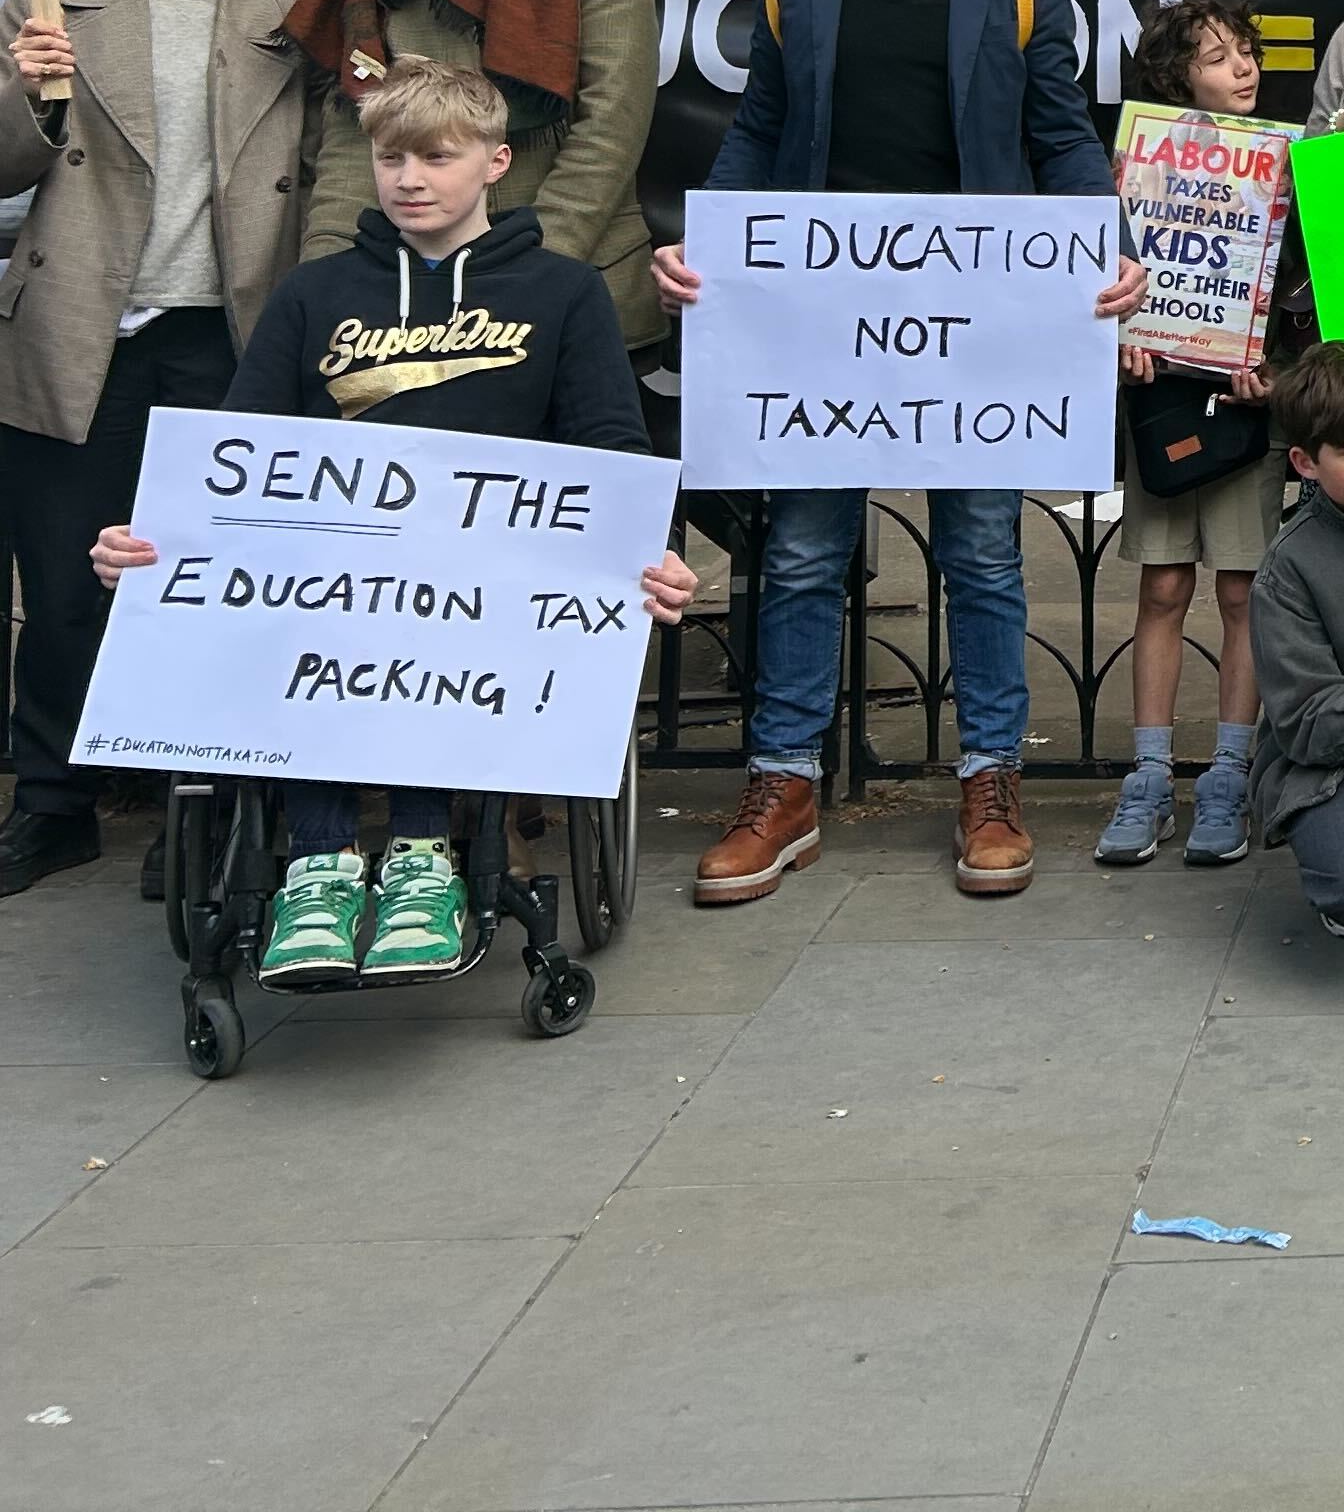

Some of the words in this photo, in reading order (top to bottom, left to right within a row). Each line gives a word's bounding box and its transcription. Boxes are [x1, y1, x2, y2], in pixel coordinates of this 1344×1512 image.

[1131, 133, 1275, 182] LABOUR
[1165, 175, 1232, 203] TAXES
[1127, 197, 1260, 234] VULNERABLE
[744, 214, 1107, 275] EDUCATION
[1140, 225, 1231, 270] KIDS
[1157, 270, 1187, 291] OF
[1193, 274, 1250, 301] THEIR
[1138, 294, 1226, 324] HOOLS
[855, 316, 972, 358] NOT
[745, 392, 1070, 445] TAXATION
[205, 438, 417, 512] SEND
[453, 471, 591, 532] THE
[159, 556, 483, 621] EDUCATION
[530, 592, 628, 634] TAX
[84, 734, 293, 765] #EDUCATIONNOTTAXATION
